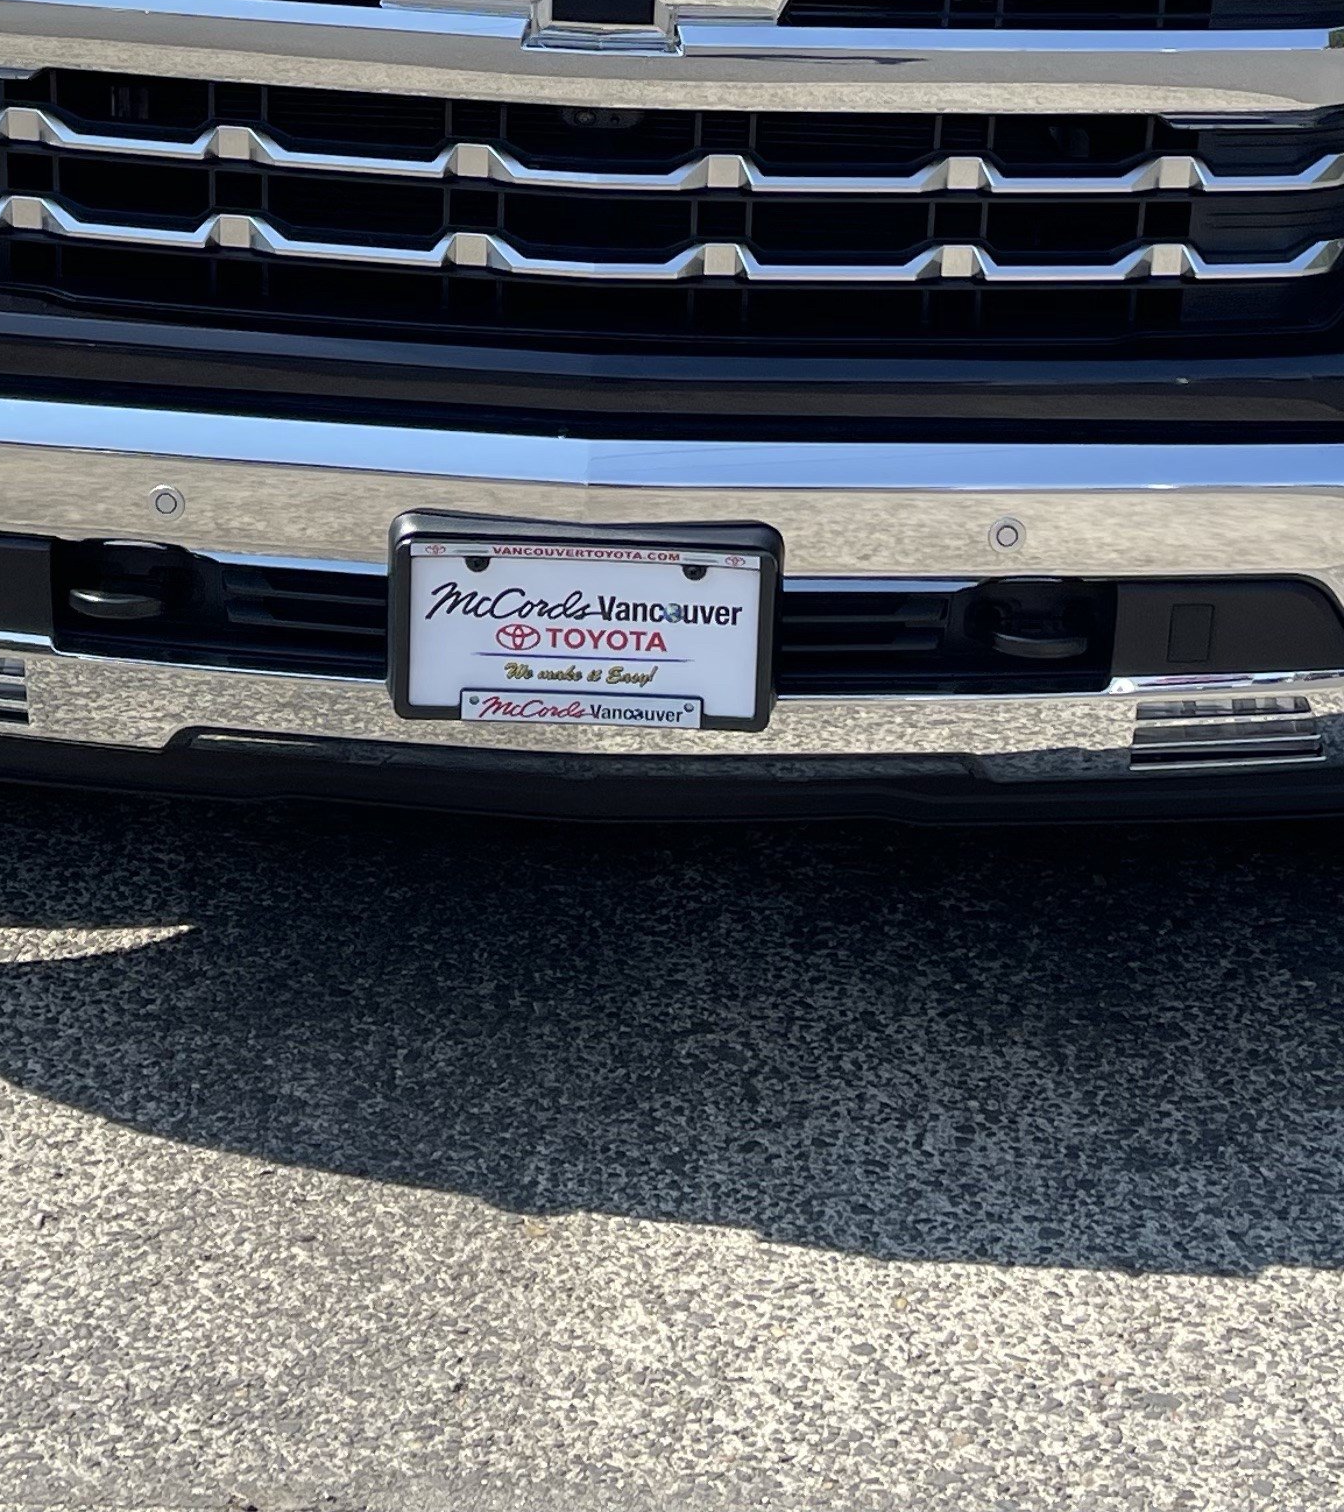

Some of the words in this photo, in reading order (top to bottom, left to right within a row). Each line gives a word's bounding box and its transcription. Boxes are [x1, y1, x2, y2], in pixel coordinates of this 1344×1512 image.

[492, 546, 681, 562] VANCOUVERTOYOTA.COM
[545, 627, 668, 653] TOYOTA
[504, 662, 534, 680] We
[537, 664, 583, 682] make
[587, 667, 602, 683] it
[605, 665, 659, 688] Easy!
